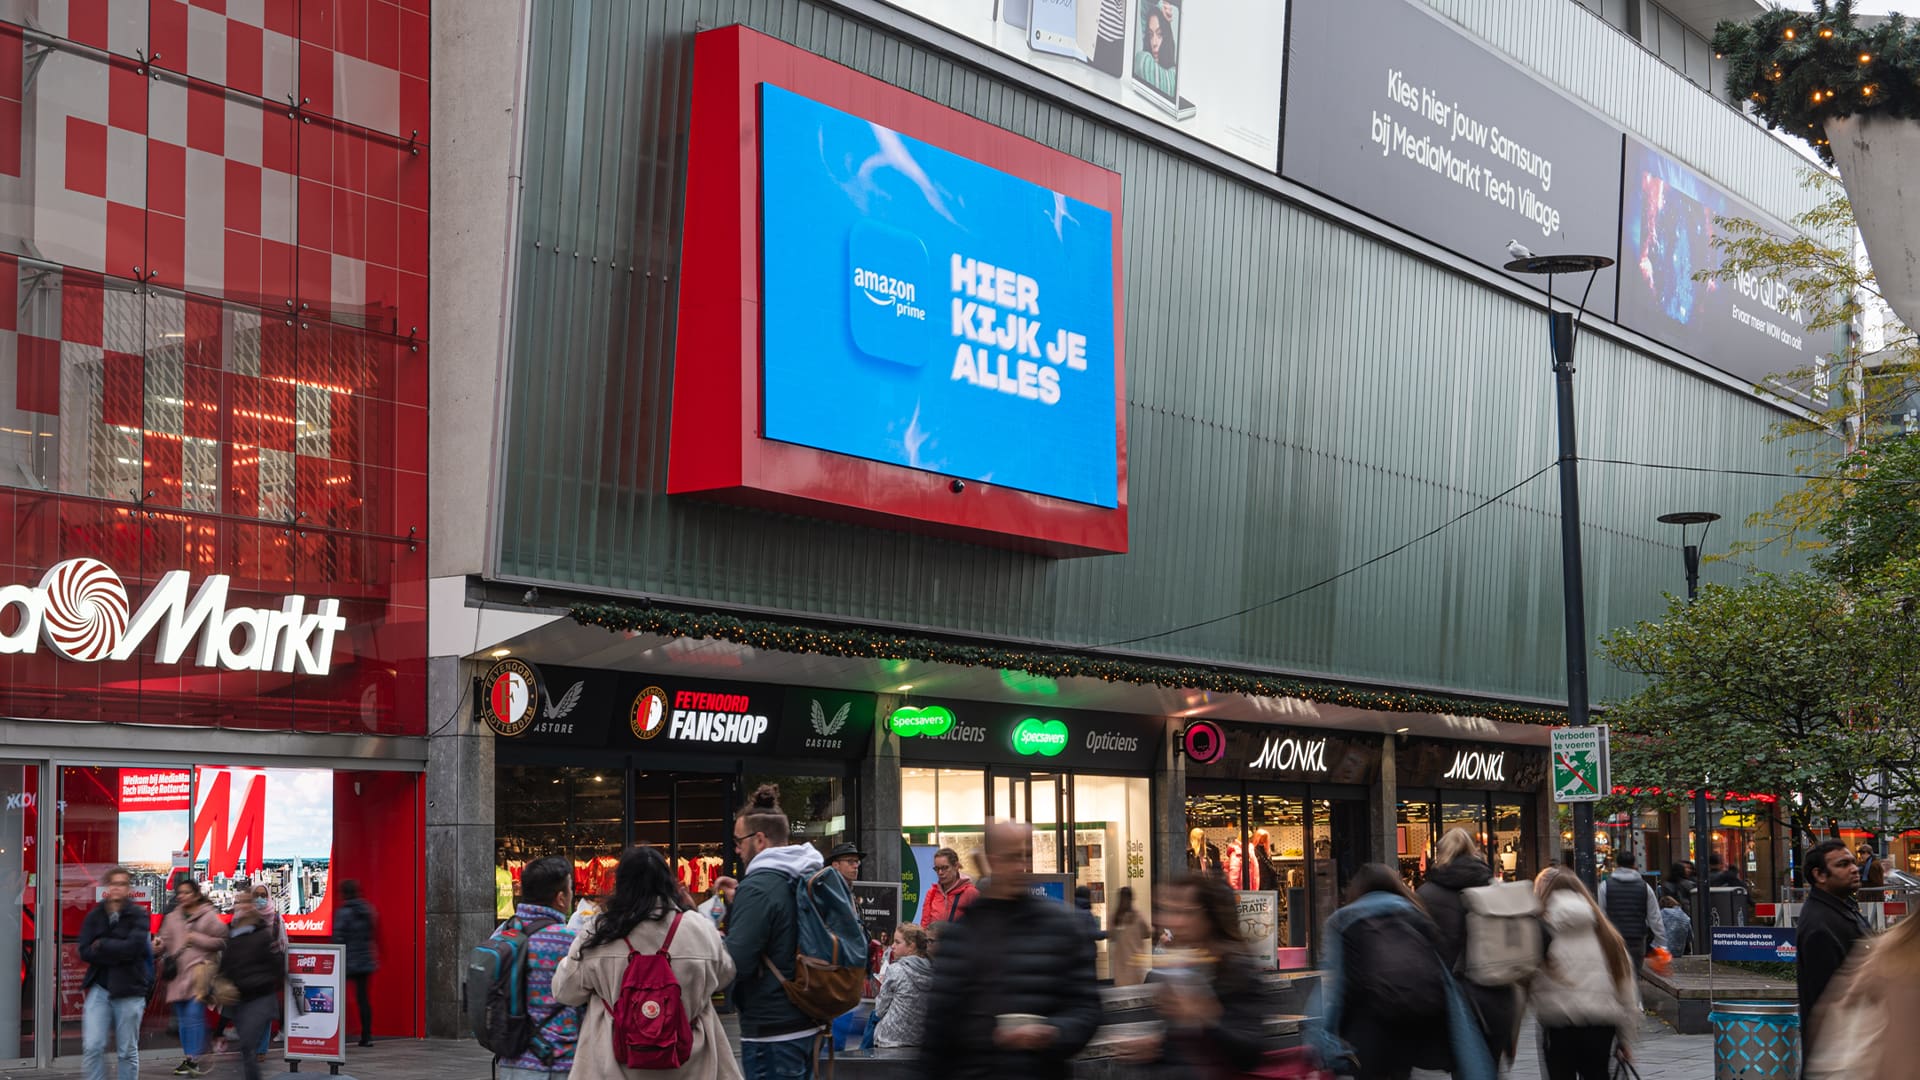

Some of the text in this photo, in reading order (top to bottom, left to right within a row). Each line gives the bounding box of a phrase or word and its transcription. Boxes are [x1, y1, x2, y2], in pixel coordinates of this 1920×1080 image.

[1388, 68, 1552, 192] Kies hier jouw Samsung
[1371, 110, 1560, 237] bij MediaMarkt Tech Village
[853, 266, 916, 302] amazon
[949, 252, 1040, 315] HIER
[896, 301, 926, 321] prime
[950, 297, 1088, 371] KIJK JE
[1766, 320, 1781, 341] WOW
[1781, 329, 1791, 346] dan
[949, 342, 1061, 405] ALLES
[110, 570, 346, 676] Markt
[486, 662, 534, 689] FEYENOORD
[500, 680, 520, 715] F
[674, 690, 750, 713] FEYENOORD
[486, 705, 535, 733] ROTTERDAM
[533, 722, 574, 734] ASTORE
[668, 710, 768, 744] FANSHOP
[893, 715, 945, 728] Specsavers
[920, 721, 987, 743] ciens
[1020, 729, 1065, 744] Specsavers
[1086, 730, 1138, 754] Opticiens
[1553, 731, 1596, 740] Verboden
[805, 738, 842, 749] CASTORE
[1554, 741, 1596, 750] te voeren
[122, 785, 137, 795] Tech
[137, 784, 159, 796] Village
[123, 774, 149, 785] Welkom
[149, 773, 158, 785] bij
[1127, 840, 1144, 852] Sale
[1127, 853, 1144, 865] Sale
[1127, 866, 1144, 878] Sale
[1236, 902, 1269, 913] GRATIS
